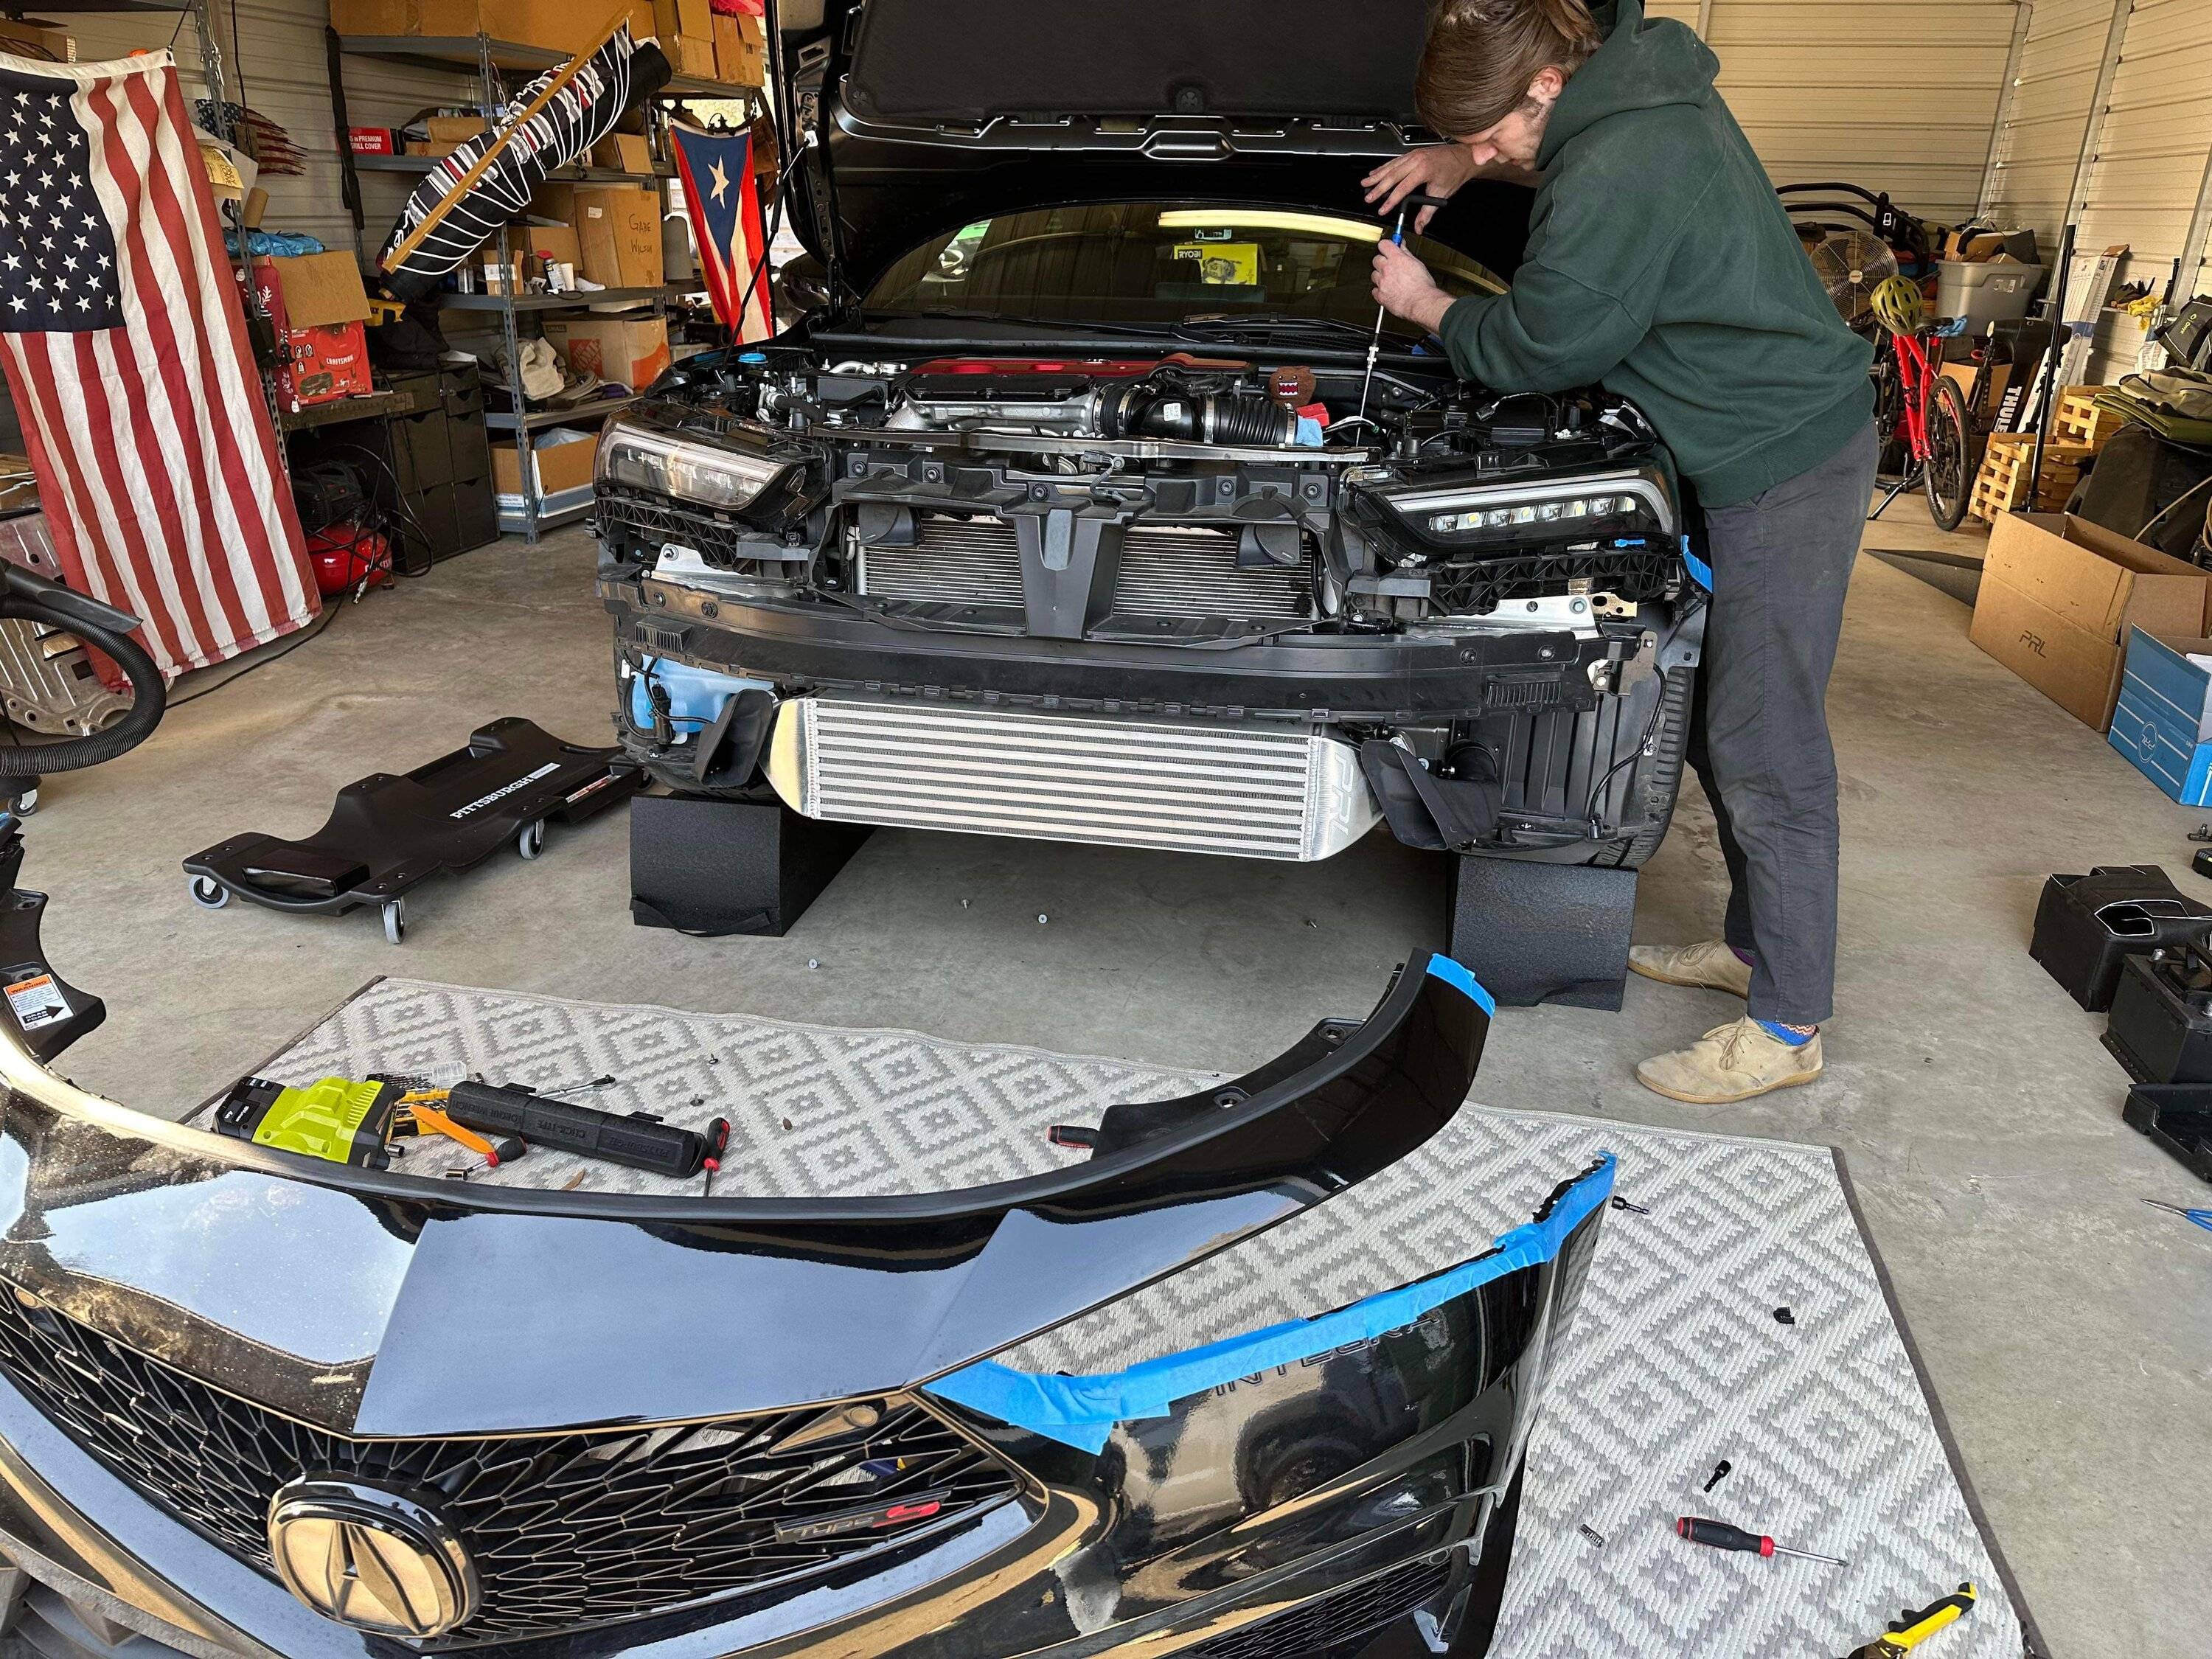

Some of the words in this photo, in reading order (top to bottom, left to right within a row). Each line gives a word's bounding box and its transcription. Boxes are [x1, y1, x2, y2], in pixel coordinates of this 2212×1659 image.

[326, 354, 354, 365] CRAFTSMAN
[1993, 386, 2023, 433] THULE
[2019, 630, 2046, 658] PRL
[449, 775, 535, 818] PITTSBURGH
[10, 981, 47, 994] WARNING
[25, 1010, 48, 1019] GRAB
